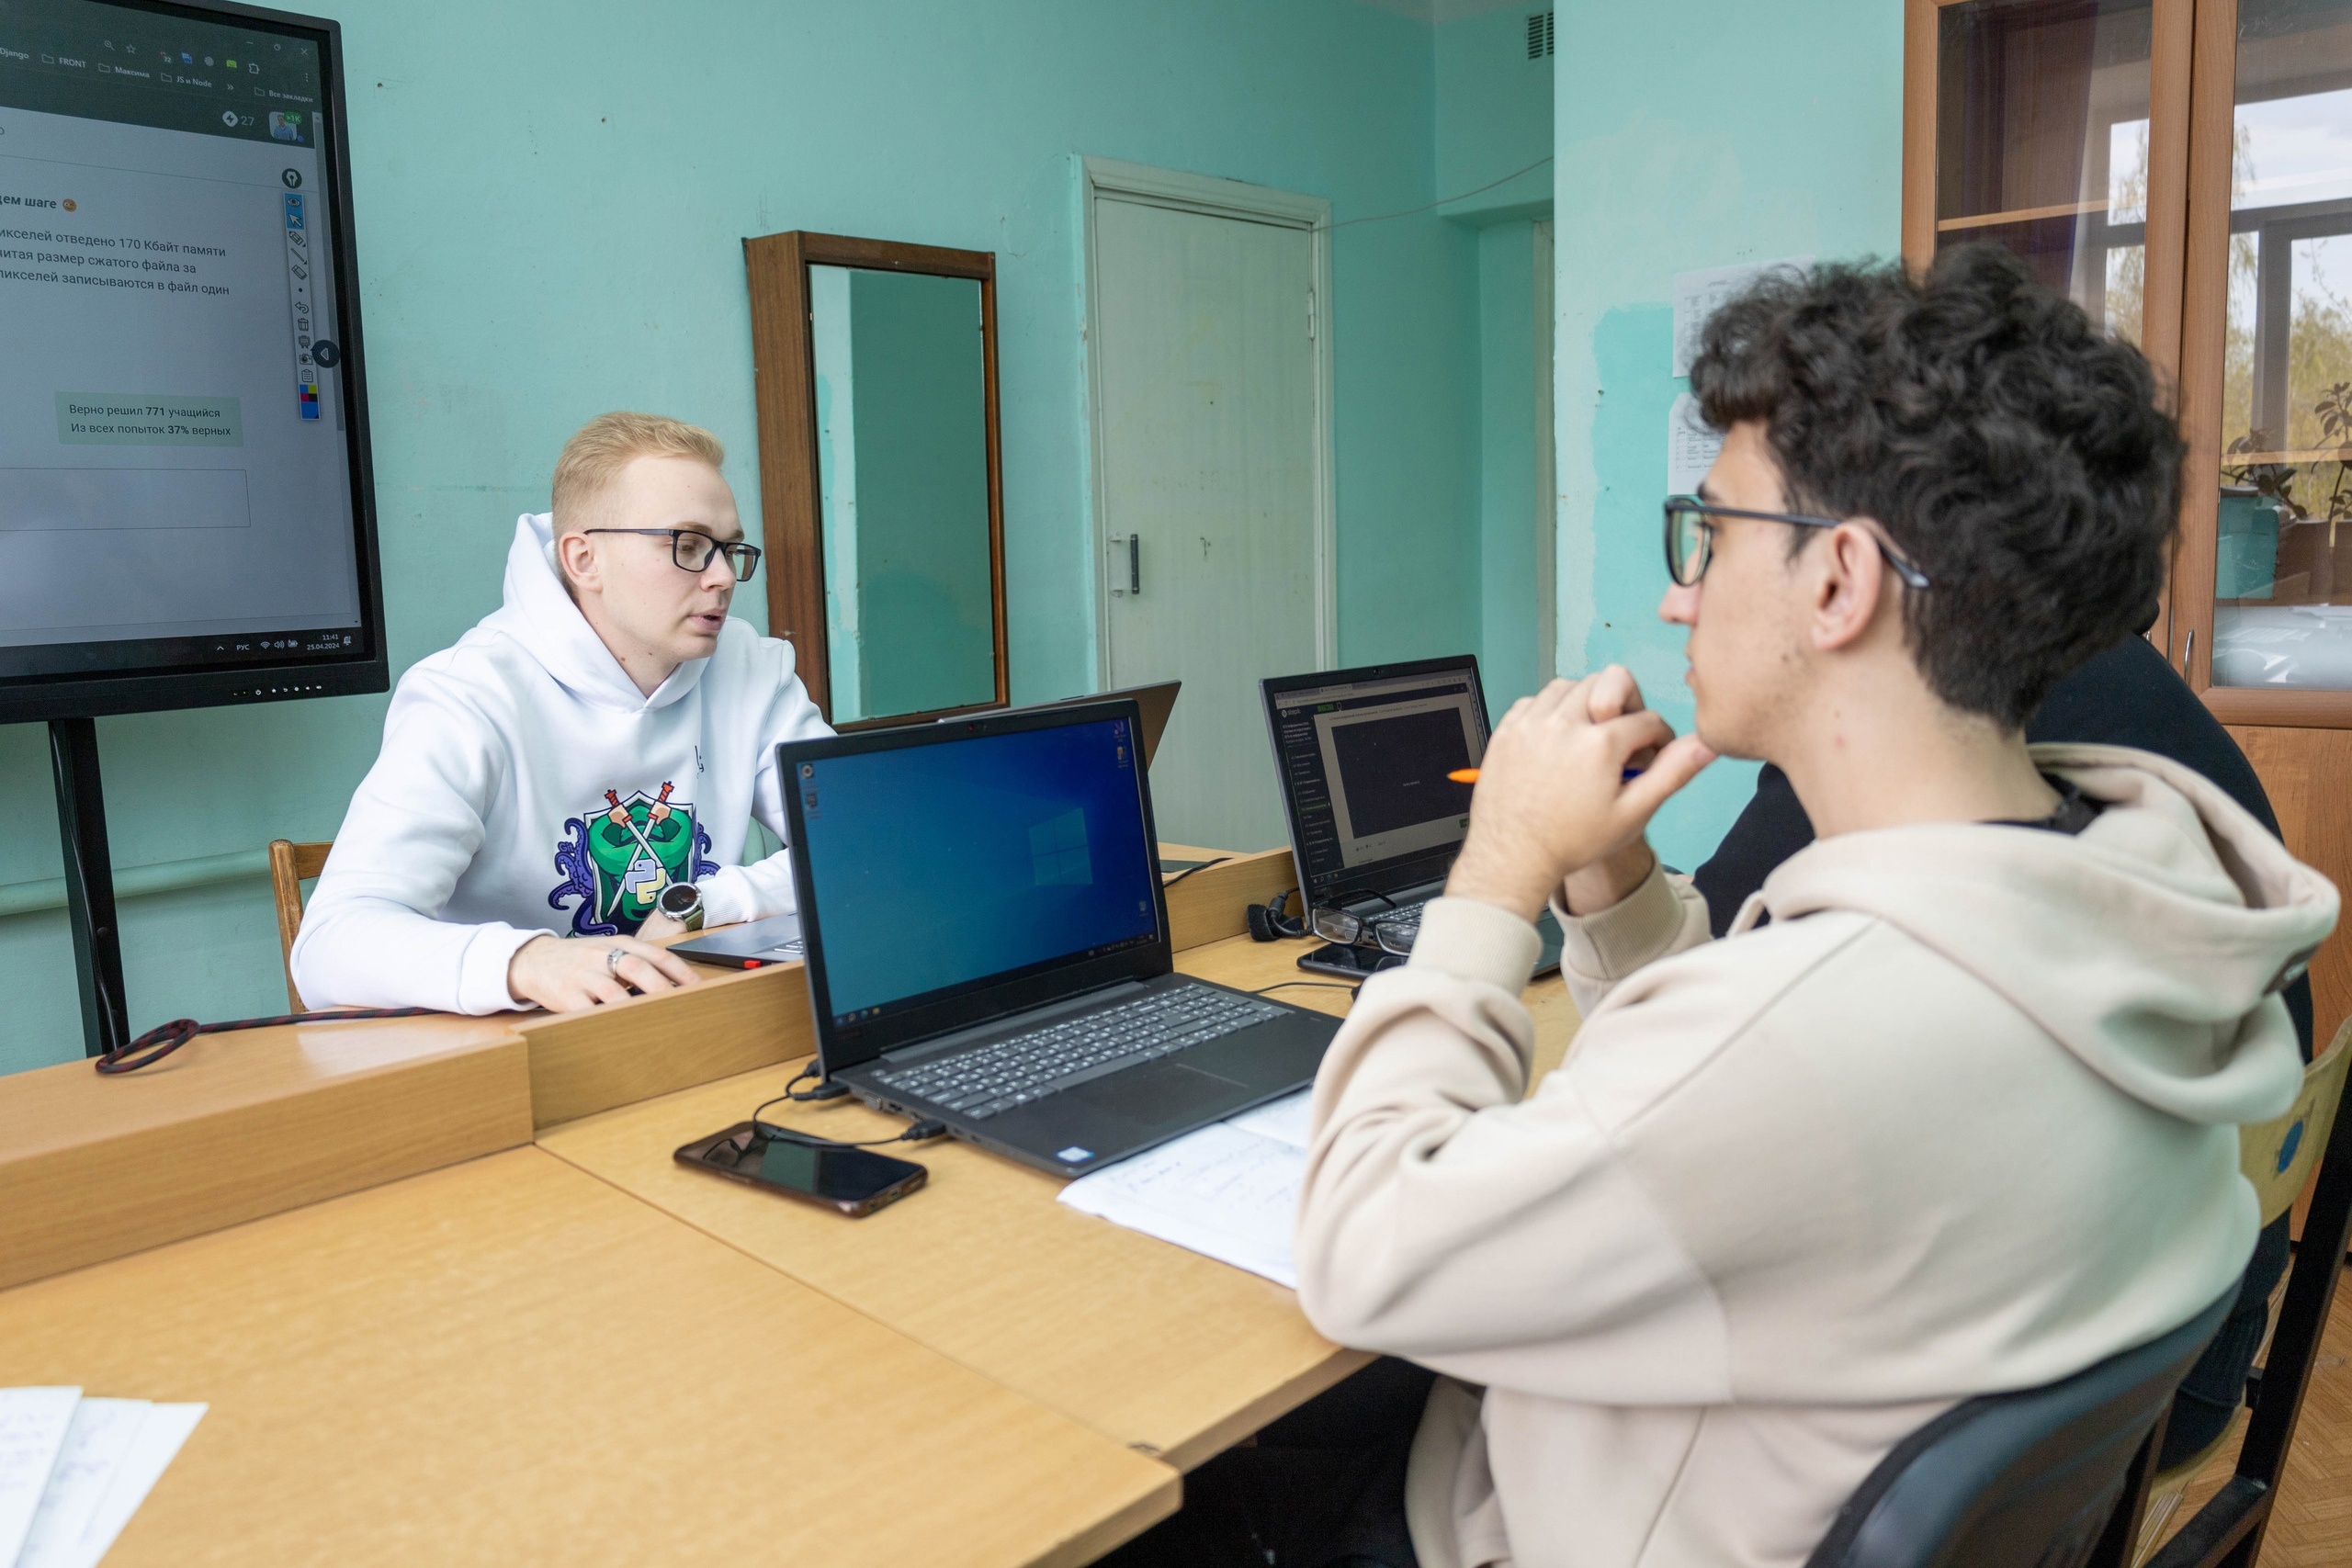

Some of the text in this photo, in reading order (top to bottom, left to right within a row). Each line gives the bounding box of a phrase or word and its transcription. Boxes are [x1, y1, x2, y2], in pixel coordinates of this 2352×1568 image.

[0, 48, 29, 60] Django
[59, 57, 86, 68] FRONT
[115, 66, 150, 78] Максима
[176, 75, 185, 85] JS
[192, 78, 212, 88] Node
[268, 90, 313, 104] Все закладки
[240, 116, 254, 127] 27
[25, 197, 57, 209] шаге
[56, 233, 116, 249] отведено
[119, 237, 141, 250] 170
[144, 239, 180, 254] Кбайт
[183, 244, 226, 258] памяти
[36, 251, 85, 267] размер
[87, 256, 140, 270] сжатого
[141, 257, 180, 274] файла
[183, 264, 197, 274] за
[62, 274, 154, 289] записываются
[157, 280, 165, 290] в
[167, 278, 198, 295] файл
[201, 284, 230, 296] один
[69, 403, 220, 419] Верно решил 771 учащийся
[71, 423, 232, 437] Из всех попыток 37% верных
[307, 642, 340, 650] 25.04.2024
[559, 842, 574, 852] Git
